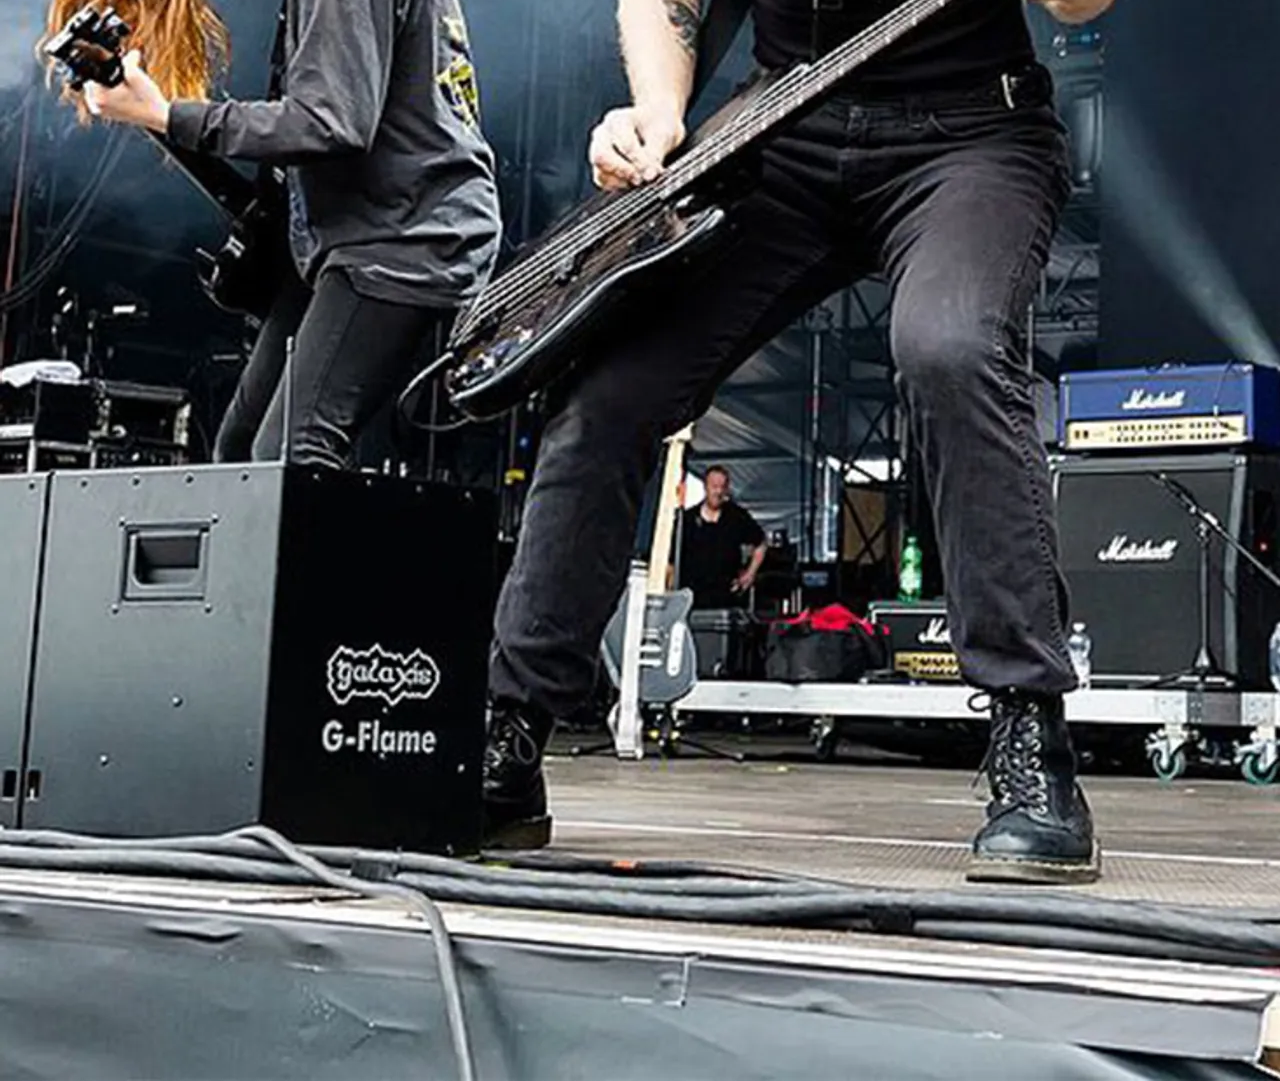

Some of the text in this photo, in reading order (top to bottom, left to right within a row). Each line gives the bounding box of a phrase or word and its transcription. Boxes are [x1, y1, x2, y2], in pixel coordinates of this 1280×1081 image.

[1121, 387, 1186, 410] Marshall
[1097, 534, 1179, 562] Marshall
[336, 658, 433, 693] galaxis
[322, 719, 438, 754] G-Flame
